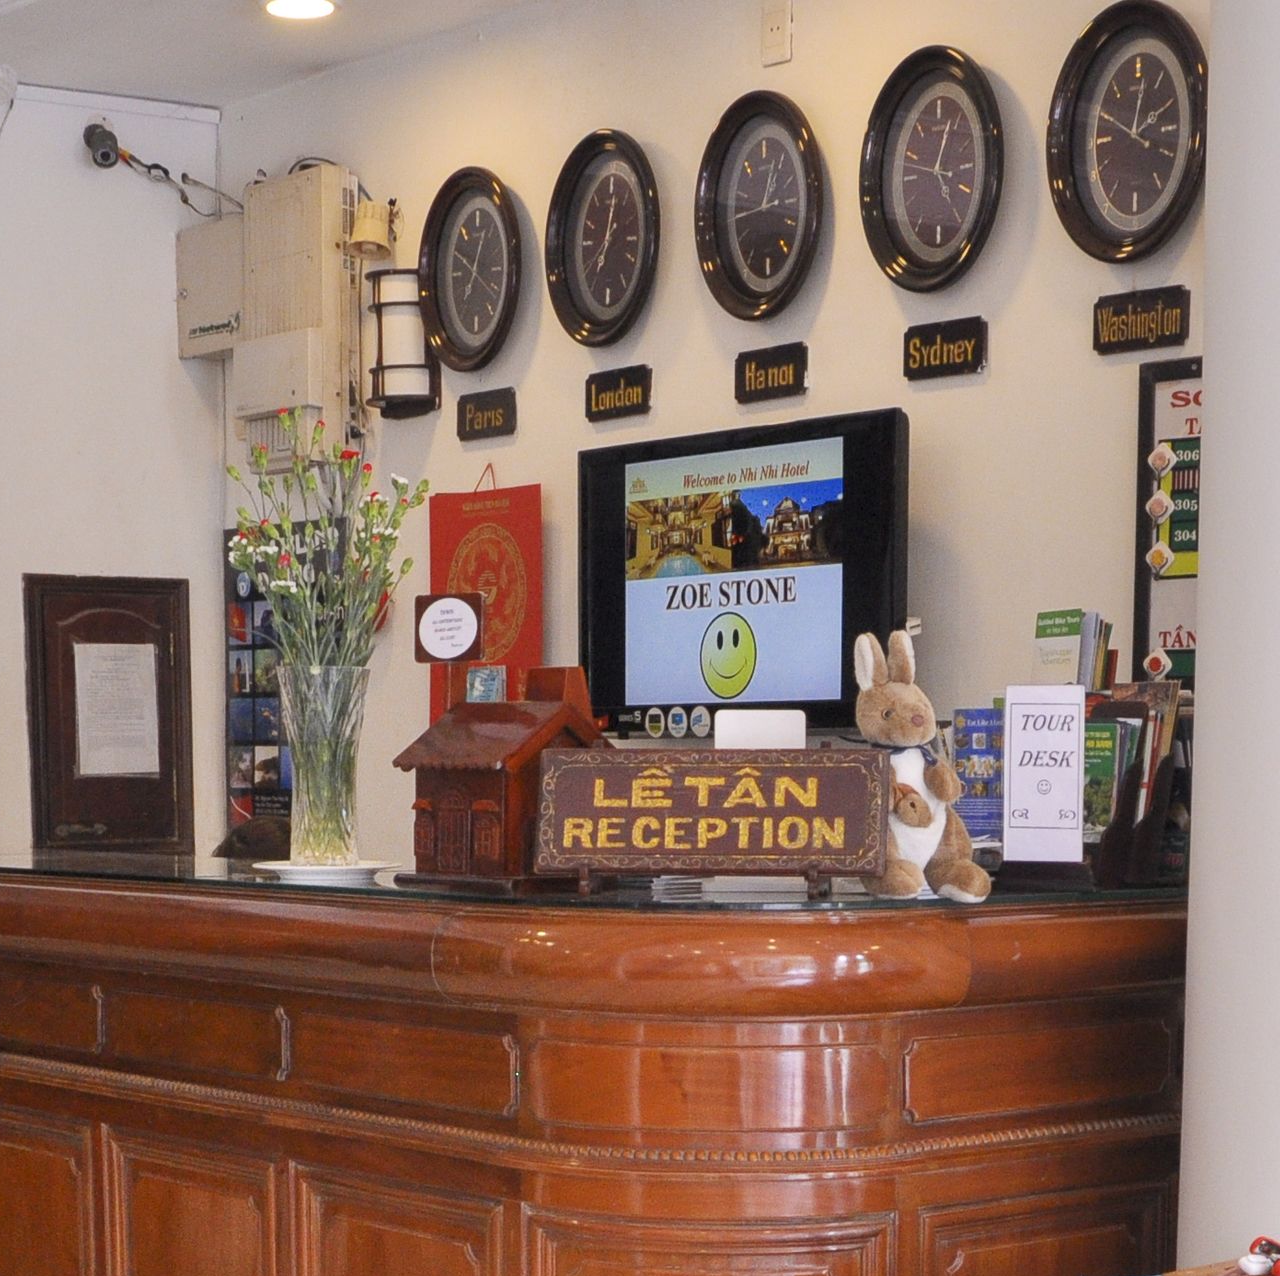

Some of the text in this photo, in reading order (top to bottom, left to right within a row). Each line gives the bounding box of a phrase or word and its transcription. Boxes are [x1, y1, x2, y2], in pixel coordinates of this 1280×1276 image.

[1097, 300, 1181, 343] Washington
[909, 334, 976, 369] Sydney
[591, 378, 643, 412] London
[465, 403, 504, 432] Paris
[1185, 418, 1202, 436] T
[1176, 449, 1200, 462] 306
[683, 460, 810, 489] Welcome to Nhi Nhi Hotel
[1174, 499, 1198, 512] 305
[1173, 529, 1197, 542] 304
[665, 576, 797, 610] ZOE STONE
[1021, 714, 1075, 733] TOUR
[1018, 751, 1076, 769] DESK
[684, 766, 819, 808] TÂN
[562, 815, 846, 850] RECEPTION
